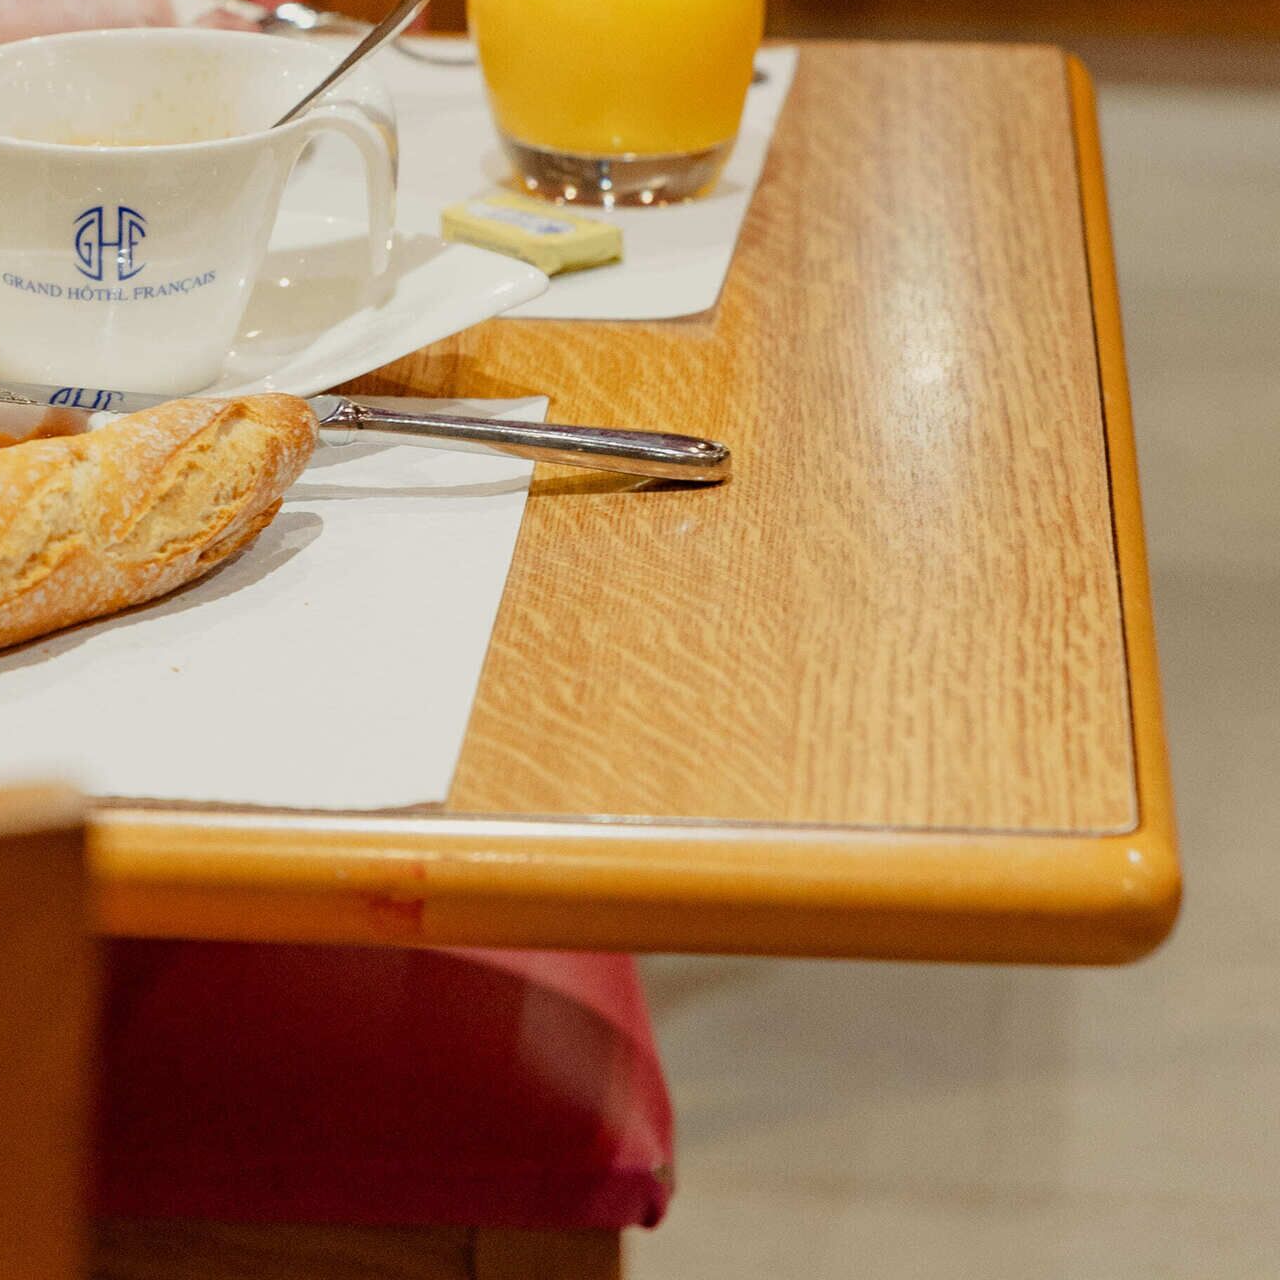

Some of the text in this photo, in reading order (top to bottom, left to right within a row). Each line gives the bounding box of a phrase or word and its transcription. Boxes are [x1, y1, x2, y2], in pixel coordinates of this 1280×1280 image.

[73, 205, 148, 282] GHF
[1, 269, 216, 302] GRAND HÔTEL FRANÇAIS
